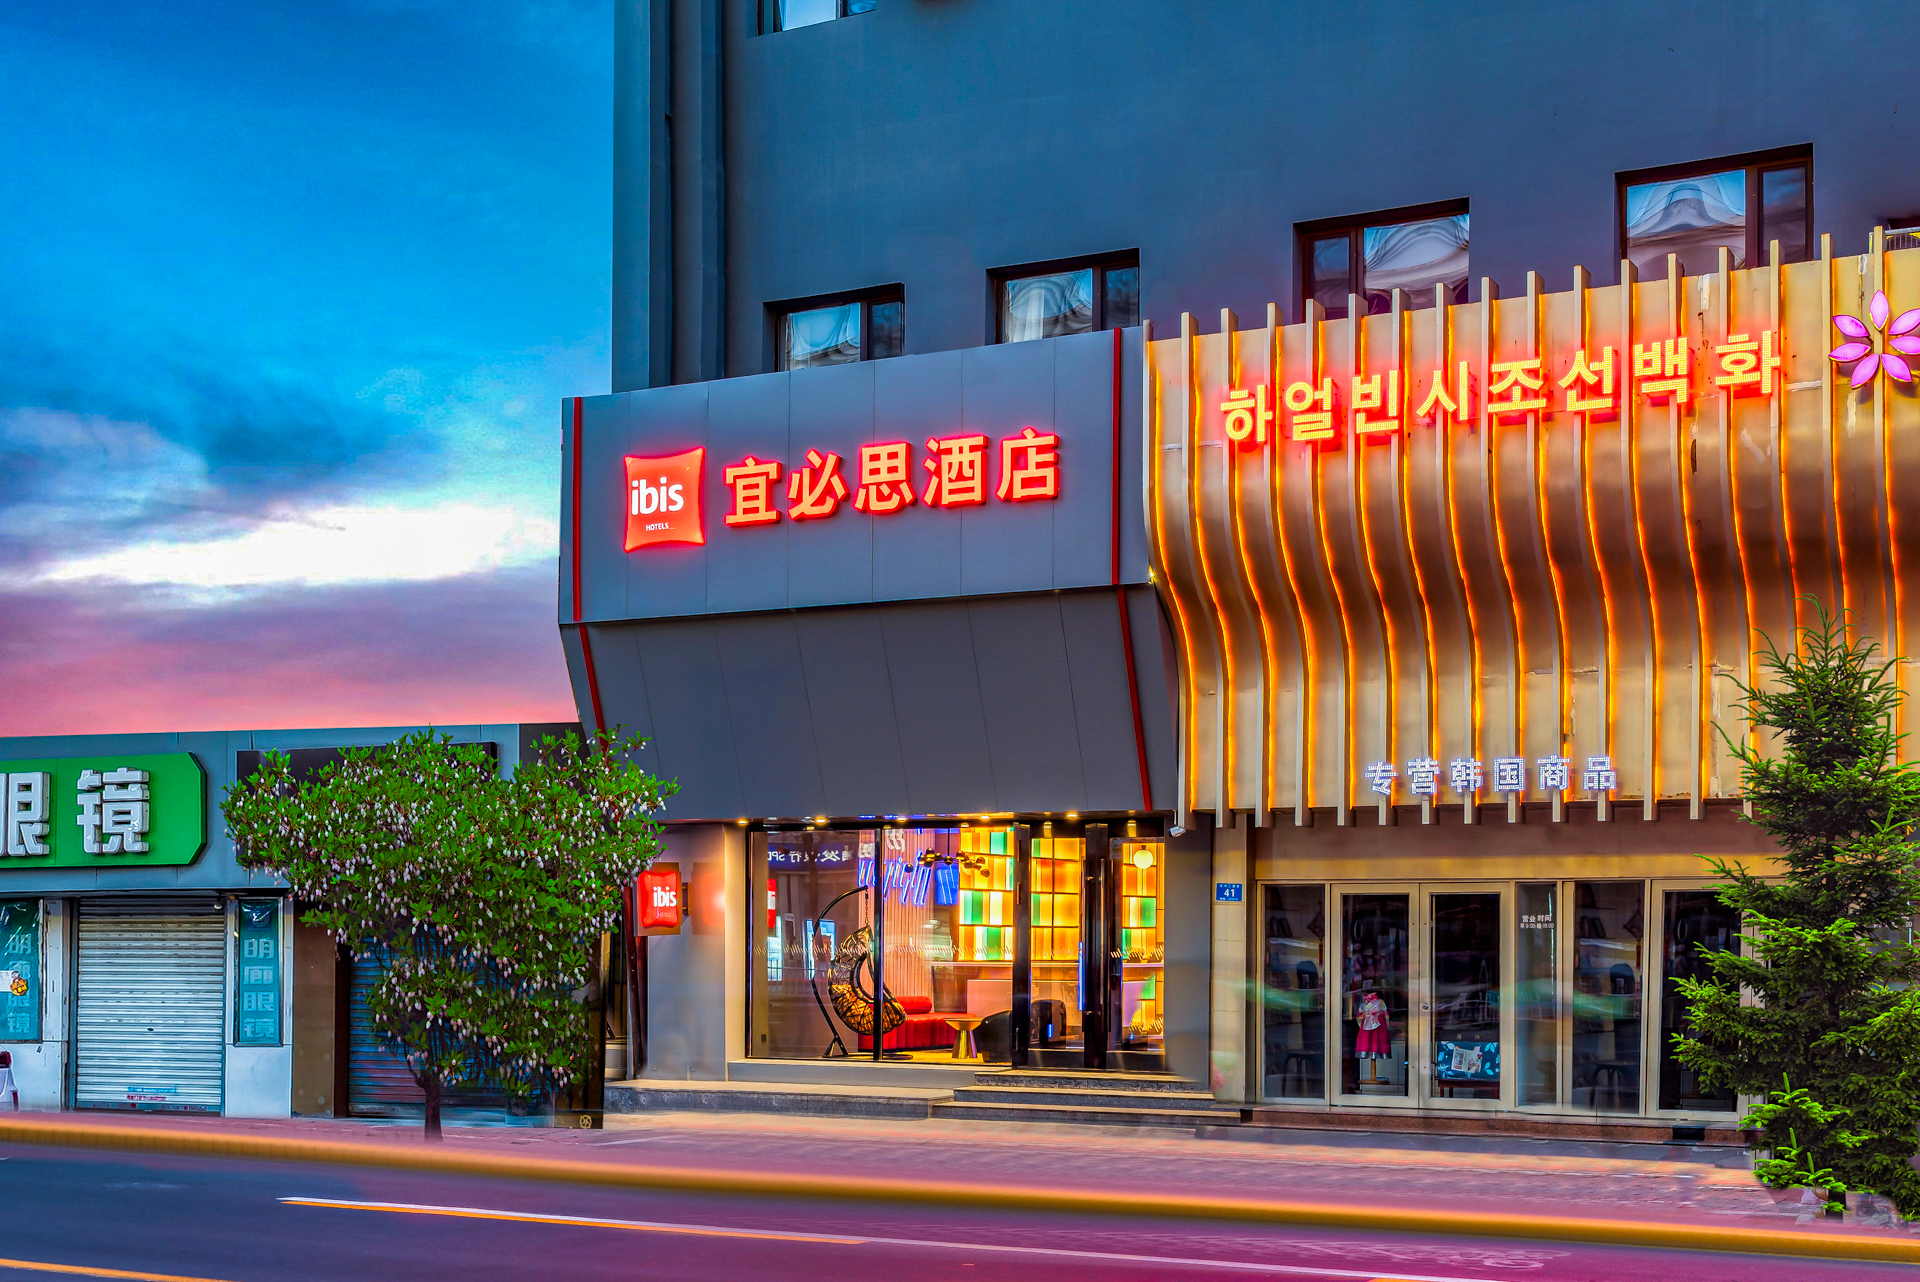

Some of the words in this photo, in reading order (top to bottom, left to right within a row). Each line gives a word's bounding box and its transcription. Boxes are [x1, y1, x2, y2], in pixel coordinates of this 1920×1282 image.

[724, 427, 1059, 527] 宜必思酒店
[631, 476, 684, 516] ibis
[645, 522, 669, 531] HOTELS
[1365, 755, 1616, 795] 专营韩国商品
[653, 886, 677, 907] ibis
[1224, 888, 1235, 897] 41
